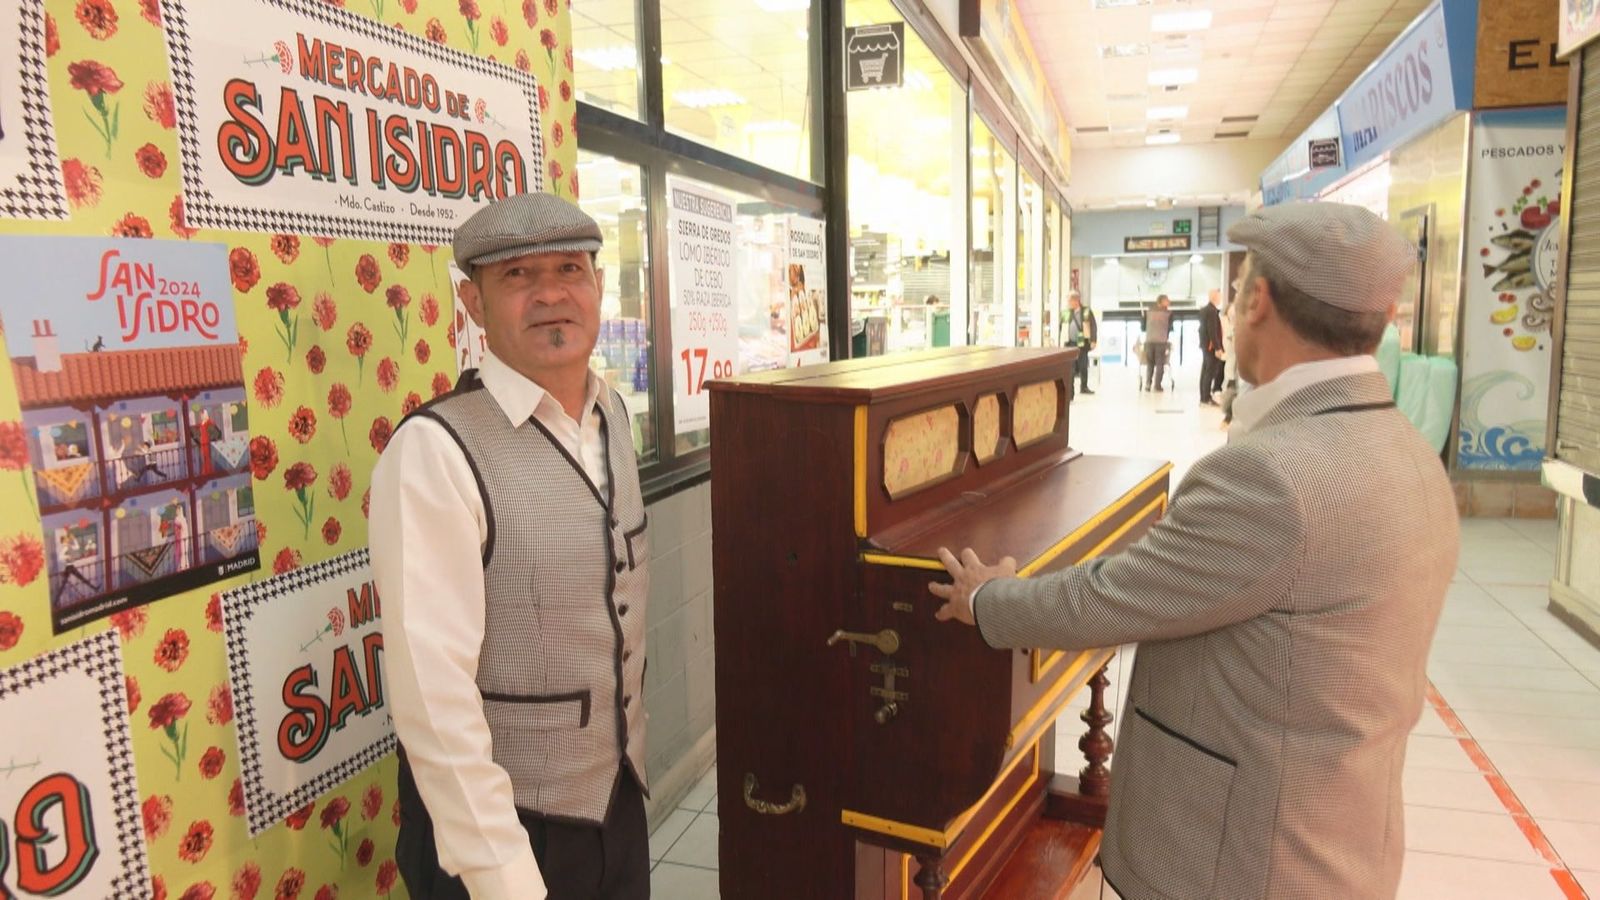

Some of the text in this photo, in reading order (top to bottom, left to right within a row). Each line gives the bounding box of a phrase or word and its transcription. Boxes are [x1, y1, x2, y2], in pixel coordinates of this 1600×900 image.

[296, 32, 471, 121] MERCADO DE
[217, 77, 528, 203] SAN ISIDRO
[1481, 144, 1566, 158] PESCADOS Y
[340, 194, 455, 219] Mdo. Castizo Desde 1952
[678, 219, 731, 245] SIERRA DE GREDOS
[680, 241, 702, 263] LOMO
[87, 249, 201, 300] SAN 2024
[694, 268, 723, 289] DE CEBO
[681, 348, 708, 396] 17
[227, 557, 255, 572] MADRID
